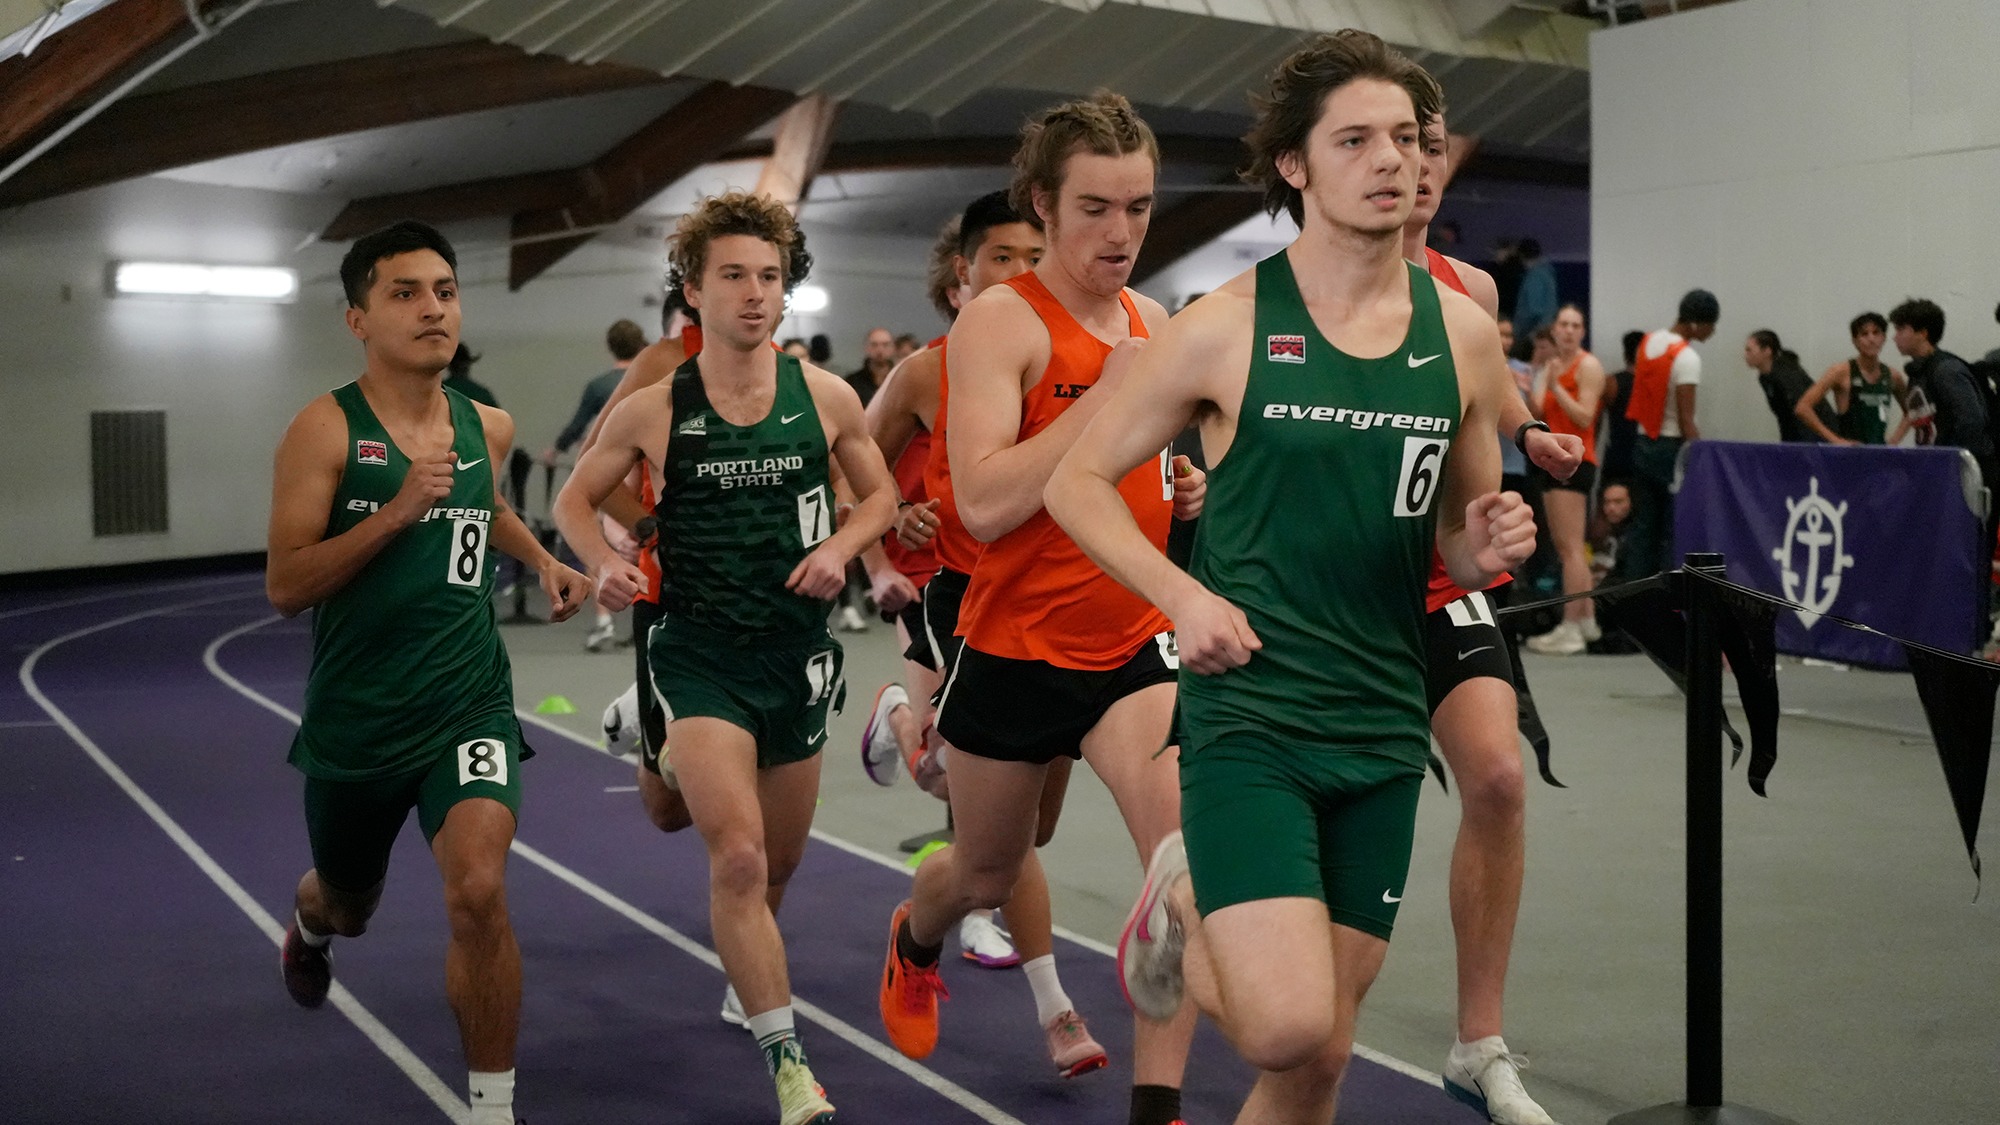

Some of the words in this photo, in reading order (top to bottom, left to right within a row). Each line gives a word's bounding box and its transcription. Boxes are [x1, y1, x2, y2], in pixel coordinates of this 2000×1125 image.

[1270, 343, 1303, 356] CCC
[1053, 384, 1091, 399] LE
[1263, 403, 1451, 432] evergreen
[360, 446, 386, 459] CCC
[696, 456, 804, 478] PORTLAND
[1405, 443, 1441, 513] 6
[719, 472, 784, 490] STATE
[346, 498, 492, 522] evgreen
[805, 490, 821, 542] 7
[457, 523, 481, 583] 8
[811, 654, 828, 698] 7
[467, 740, 498, 778] 8
